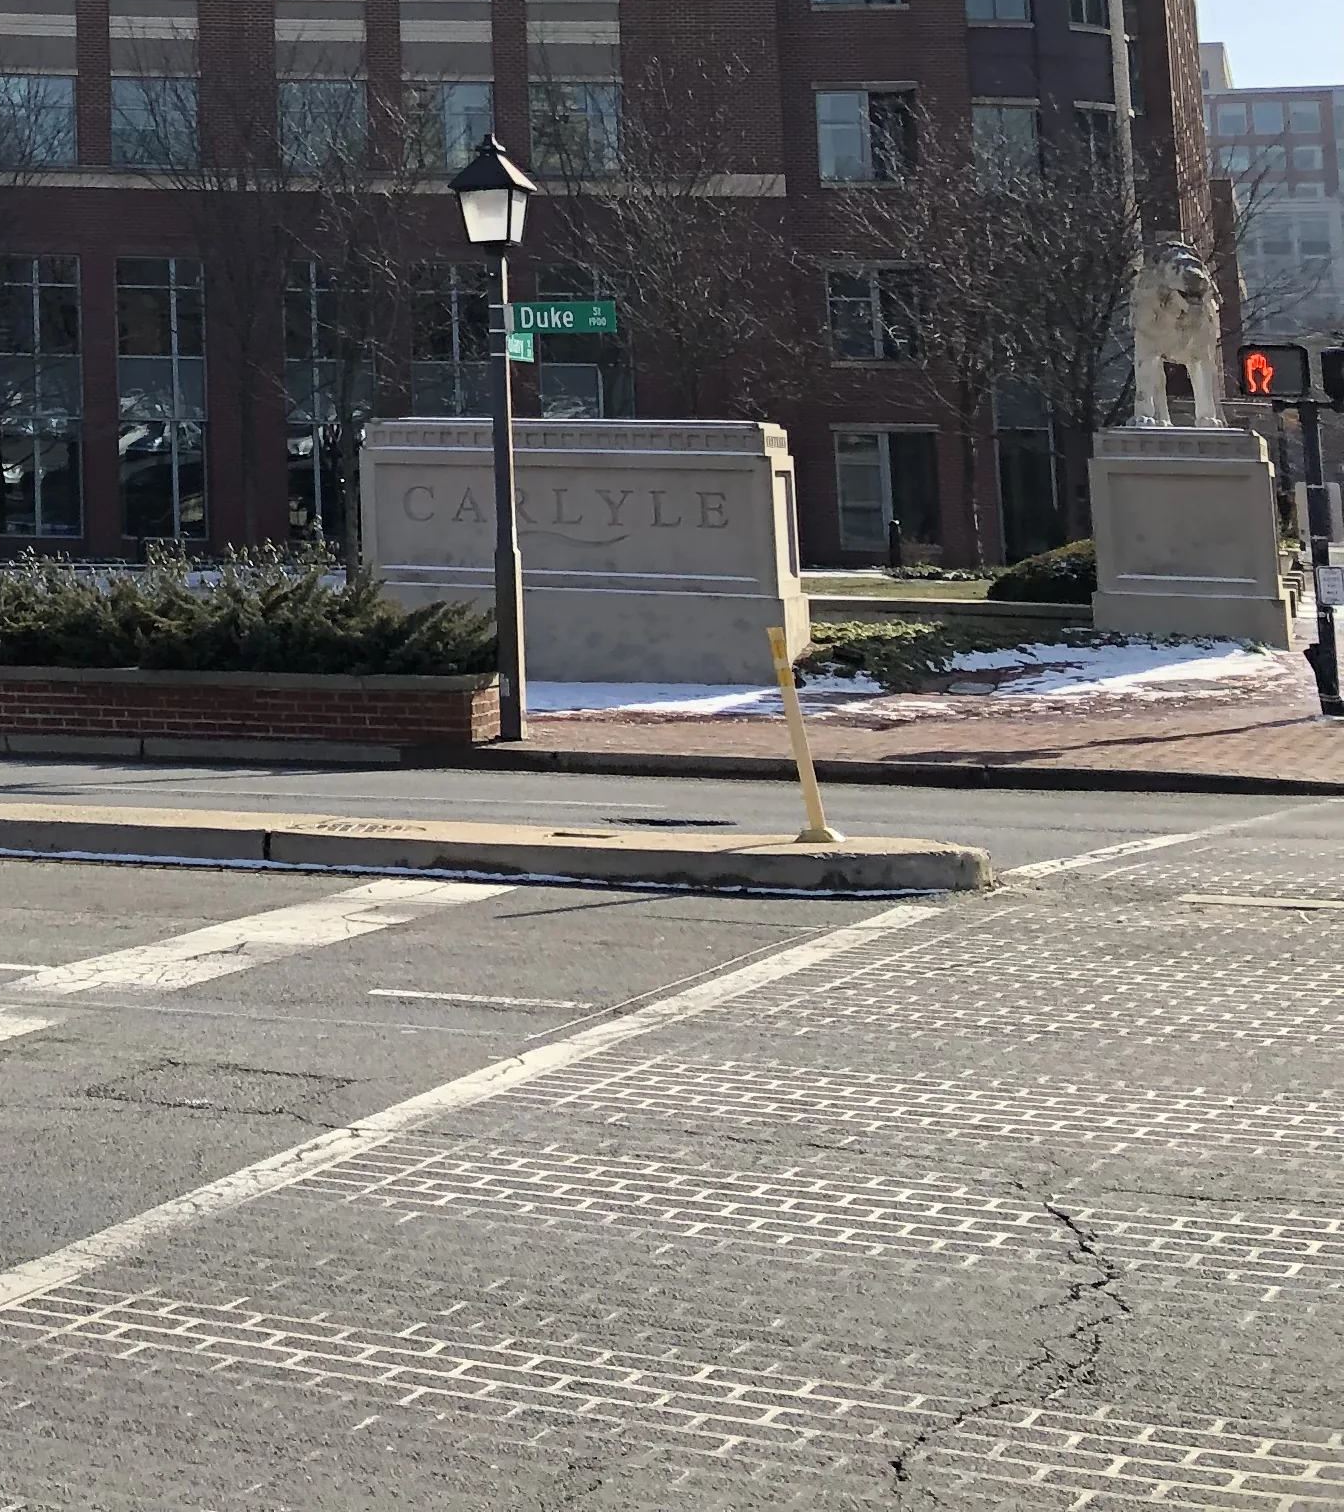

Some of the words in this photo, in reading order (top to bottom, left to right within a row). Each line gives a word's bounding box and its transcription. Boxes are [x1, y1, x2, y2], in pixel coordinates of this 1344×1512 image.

[520, 306, 574, 328] Duke
[592, 307, 601, 316] St
[403, 486, 730, 529] CARLYLE
